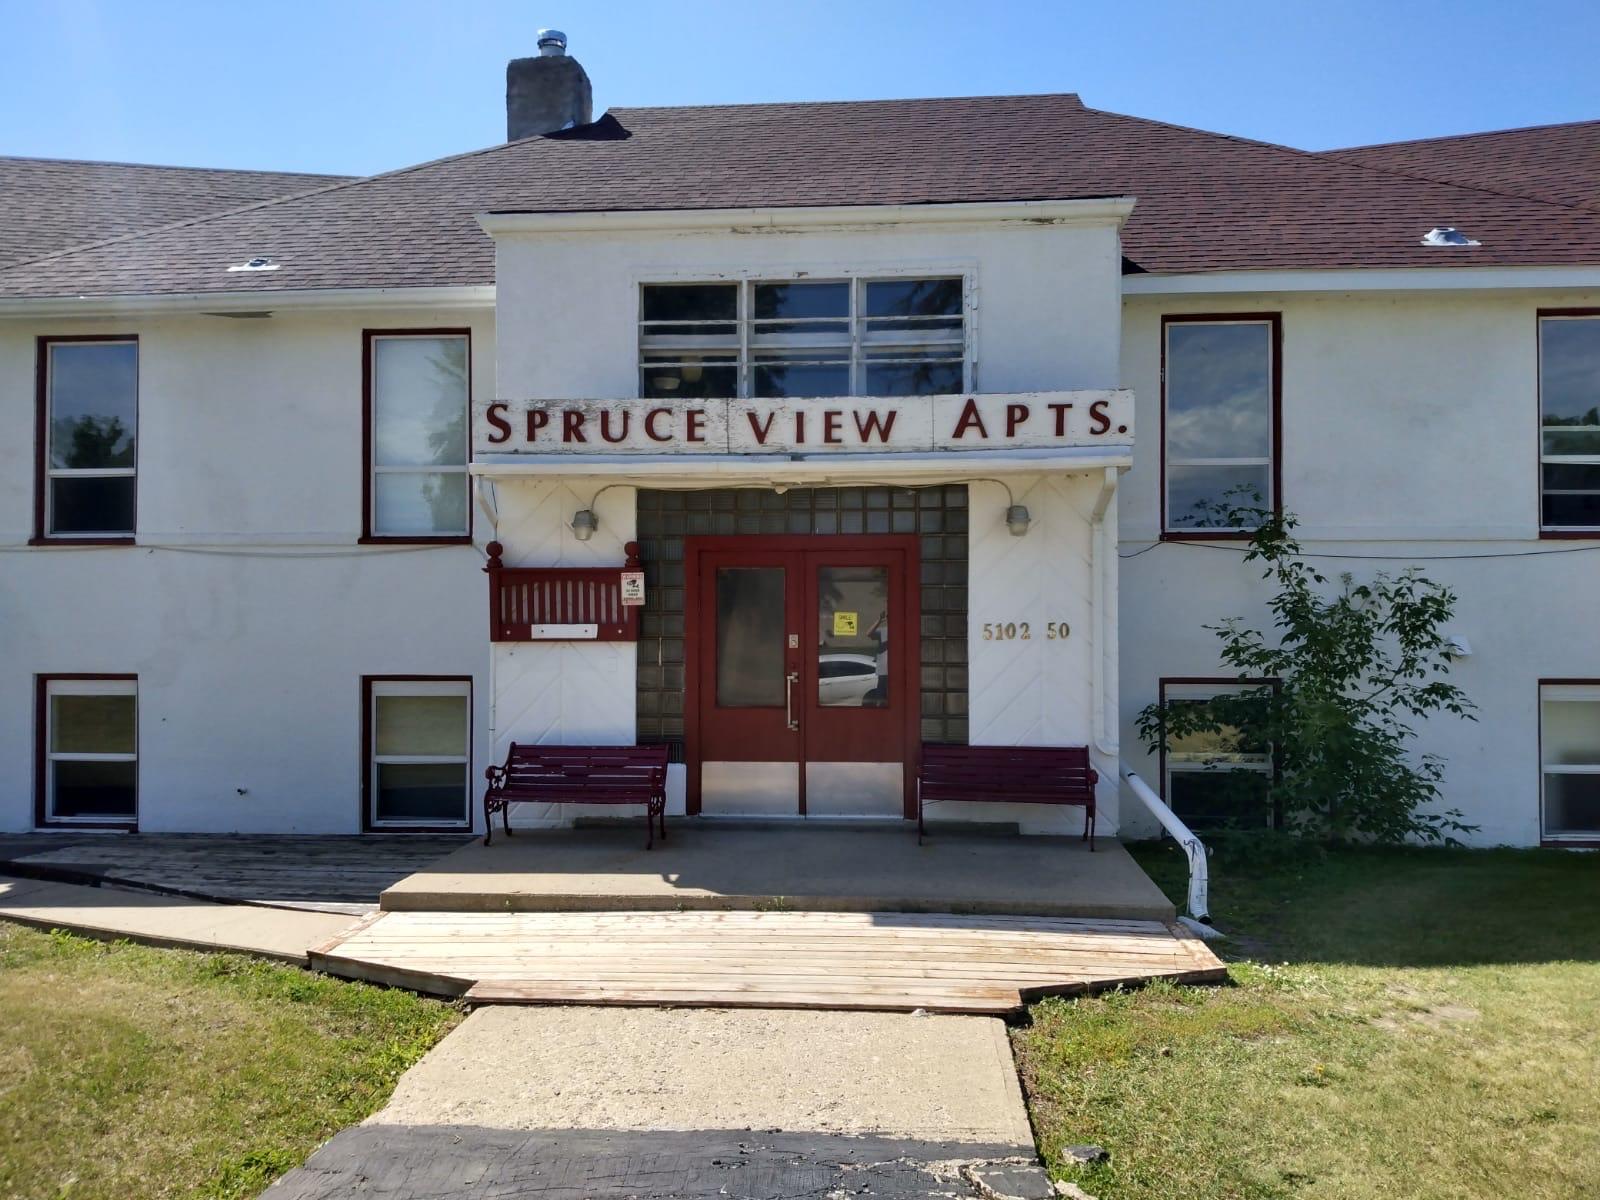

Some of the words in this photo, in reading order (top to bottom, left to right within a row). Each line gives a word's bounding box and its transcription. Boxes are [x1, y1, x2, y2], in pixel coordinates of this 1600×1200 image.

[486, 403, 706, 444] SPRUCE
[746, 410, 898, 445] VIEW
[951, 399, 1129, 438] APTS.
[983, 622, 1031, 640] 5102
[1047, 622, 1070, 640] 50
